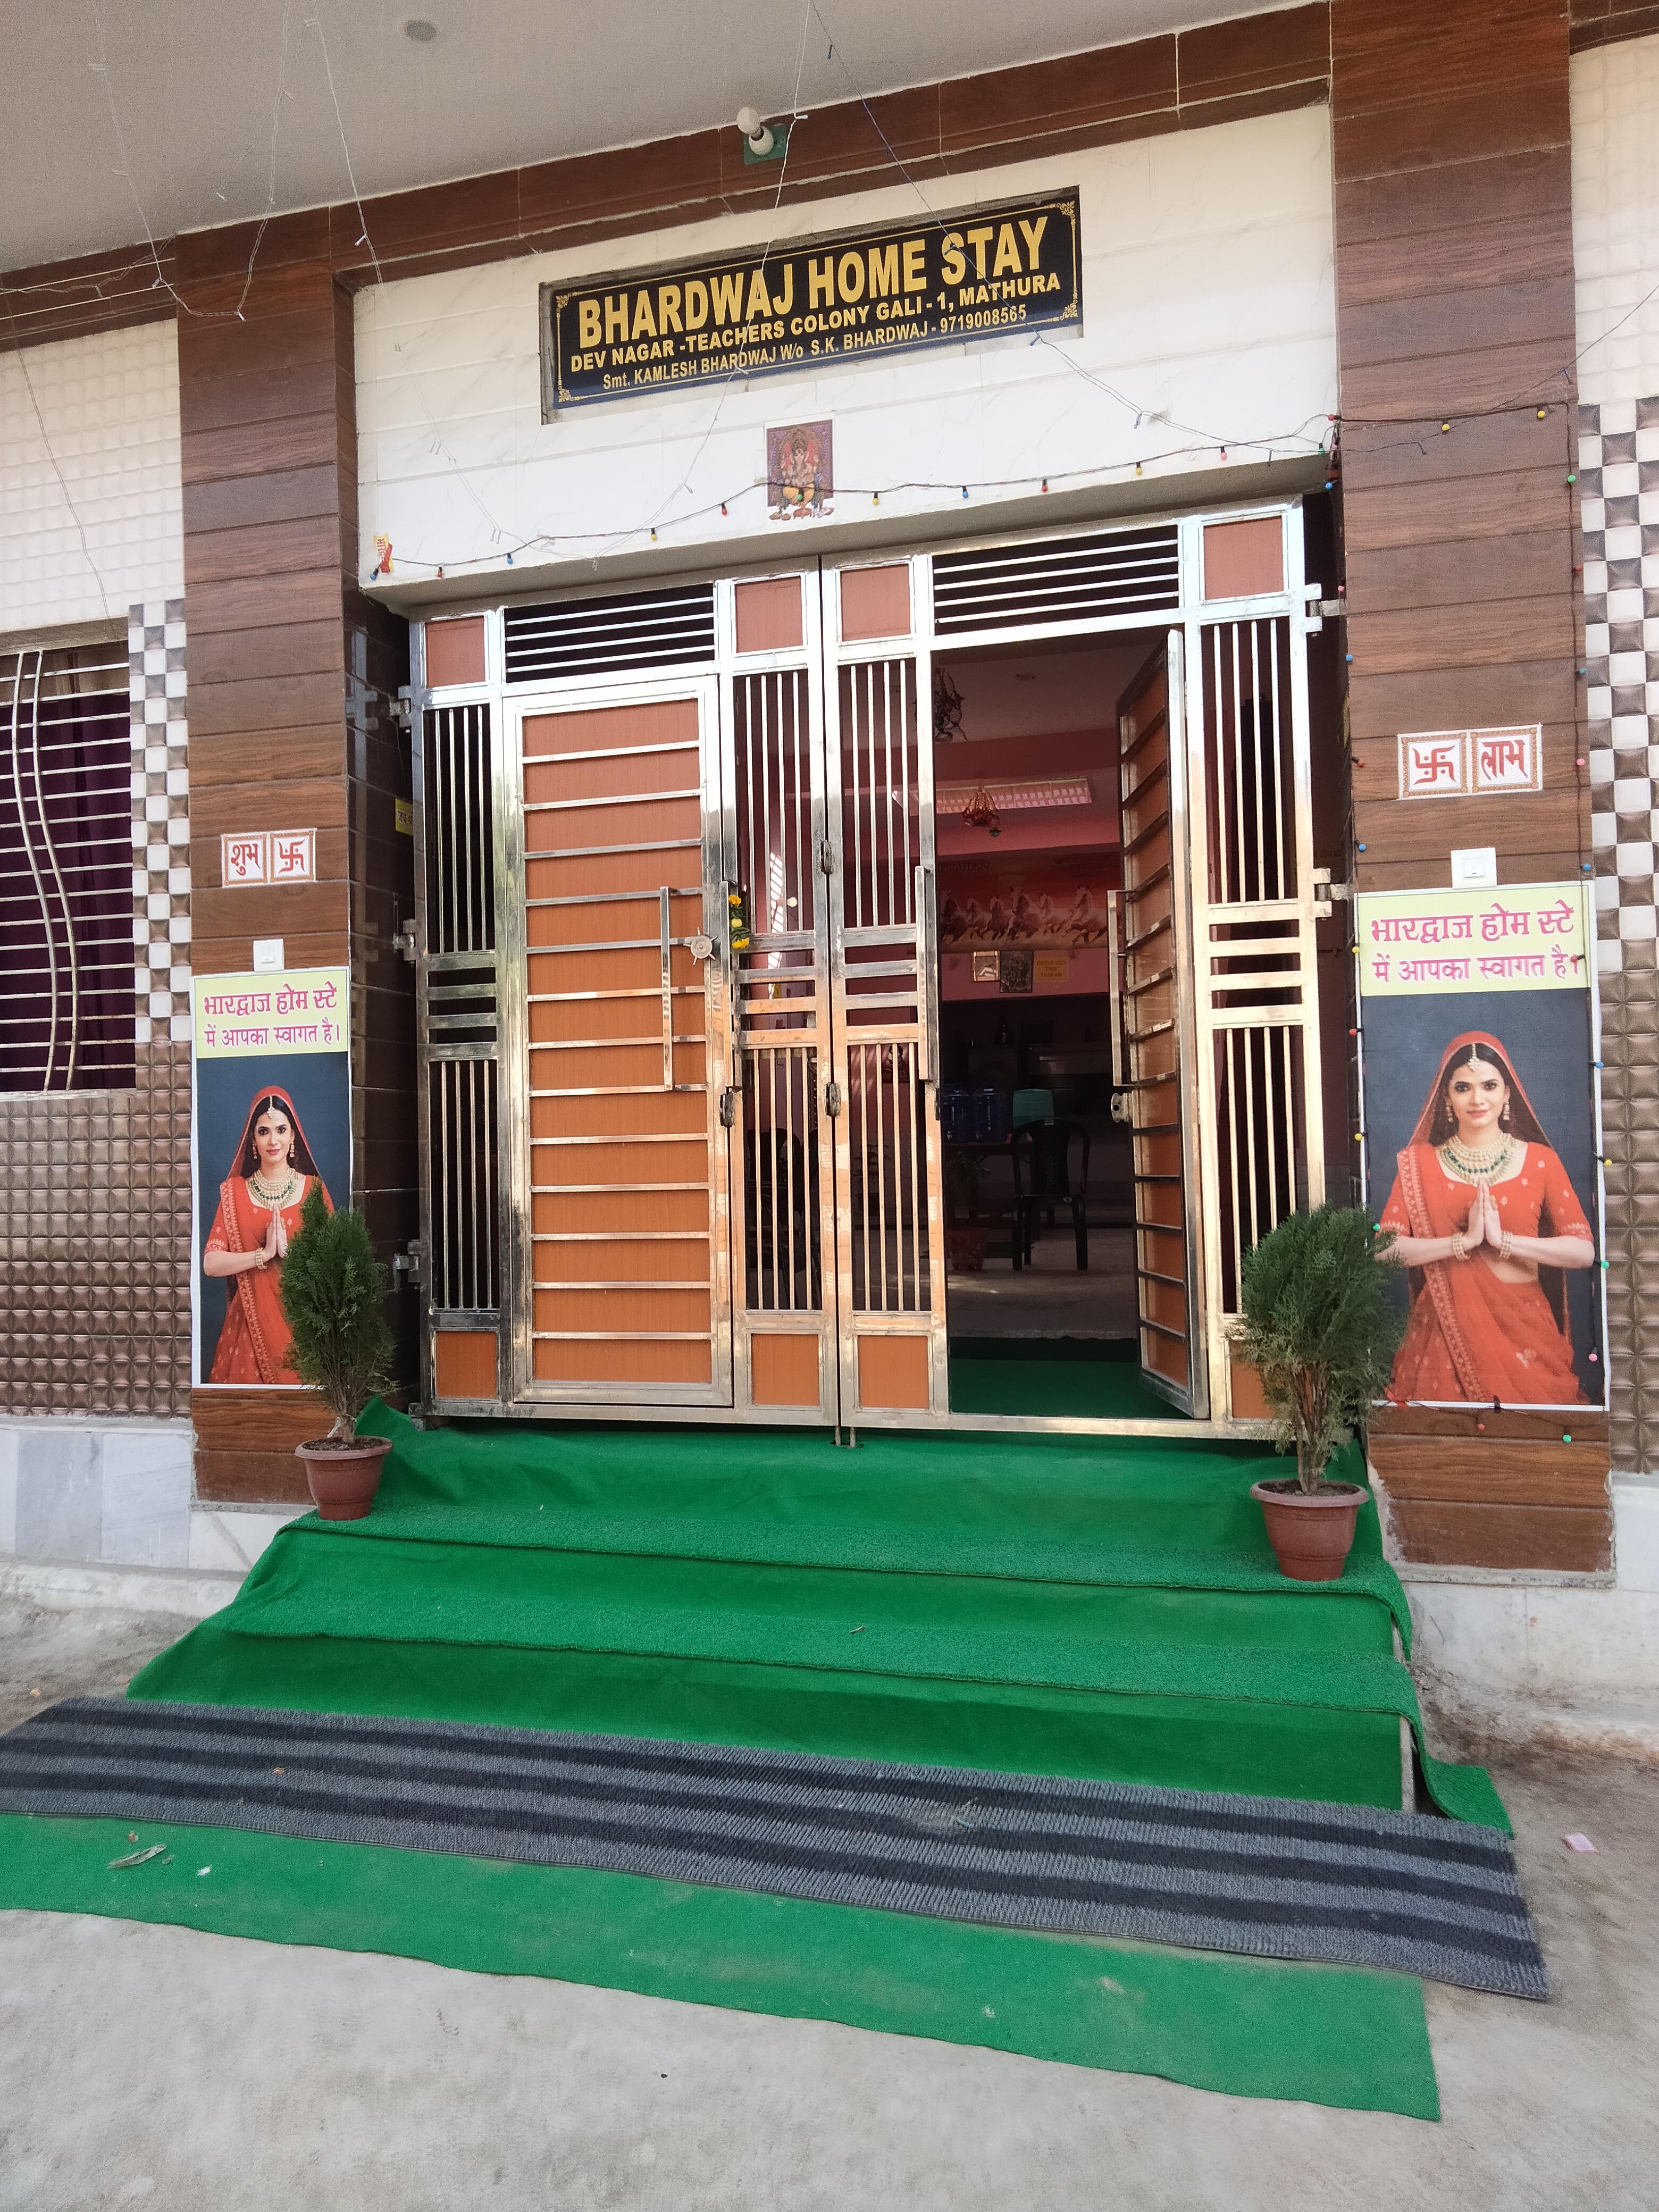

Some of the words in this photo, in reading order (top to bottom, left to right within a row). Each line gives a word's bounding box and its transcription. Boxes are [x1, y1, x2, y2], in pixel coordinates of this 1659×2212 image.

[579, 264, 793, 348] BHARDWAJ
[809, 239, 926, 309] HOME
[942, 216, 1048, 284] STAY
[571, 351, 606, 372] DEV
[612, 340, 674, 365] NAGAR
[791, 305, 869, 335] COLONY
[876, 297, 921, 320] GALI
[959, 272, 1061, 306] MATHURA
[604, 372, 631, 390] Smt.
[634, 359, 697, 384] KAMLESH
[701, 347, 776, 373] BHARDWAJ
[781, 343, 803, 361] W/o
[811, 337, 839, 356] S.K.
[844, 321, 927, 350] BHARDWAJ
[941, 304, 1026, 333] 9719008565
[1481, 740, 1528, 781] लाभ
[231, 843, 261, 876] शुभ
[1371, 915, 1473, 943] भारद्वाज
[1480, 903, 1531, 941] होम
[1537, 900, 1574, 934] स्टे
[1372, 953, 1391, 982] में
[1398, 959, 1471, 981] आपका
[1476, 955, 1546, 979] स्वागत
[204, 993, 271, 1016] भारद्वाज
[275, 984, 308, 1014] होम
[313, 981, 337, 1008] स्टे
[204, 1023, 216, 1047] में
[222, 1027, 269, 1046] आपका
[273, 1025, 318, 1044] स्वागत
